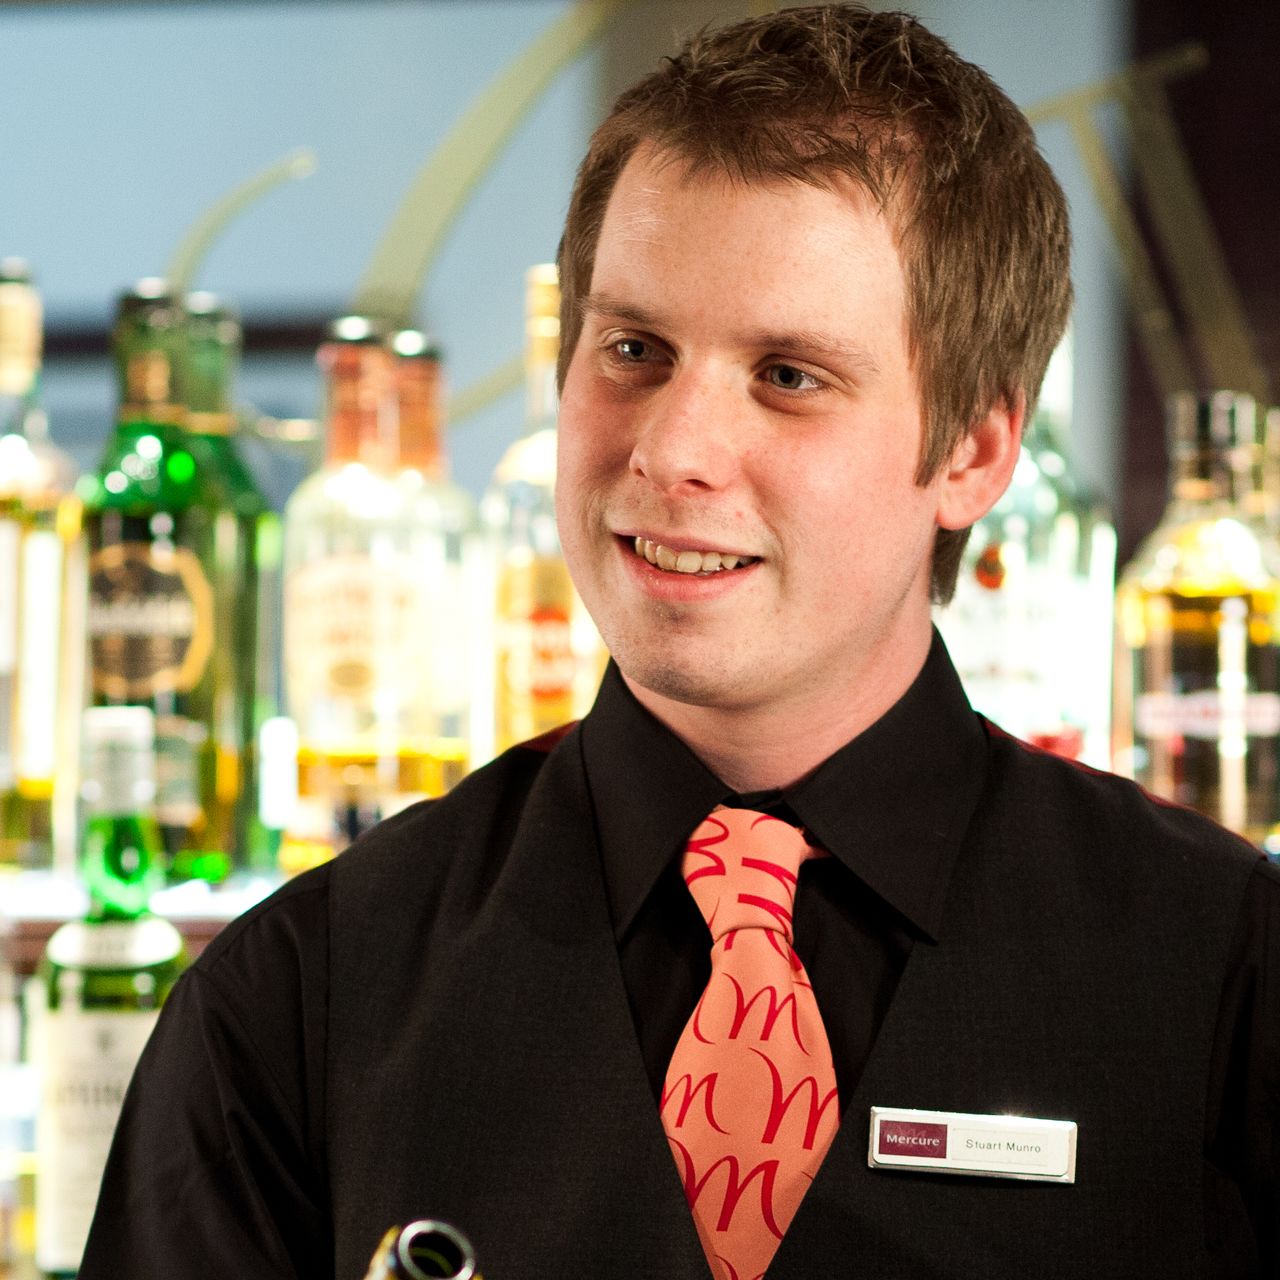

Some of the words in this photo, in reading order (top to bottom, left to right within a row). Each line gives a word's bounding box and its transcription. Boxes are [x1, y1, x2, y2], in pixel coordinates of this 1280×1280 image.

[886, 1133, 940, 1147] Mercure
[966, 1138, 1002, 1151] Stuart
[1006, 1142, 1042, 1154] Munro
